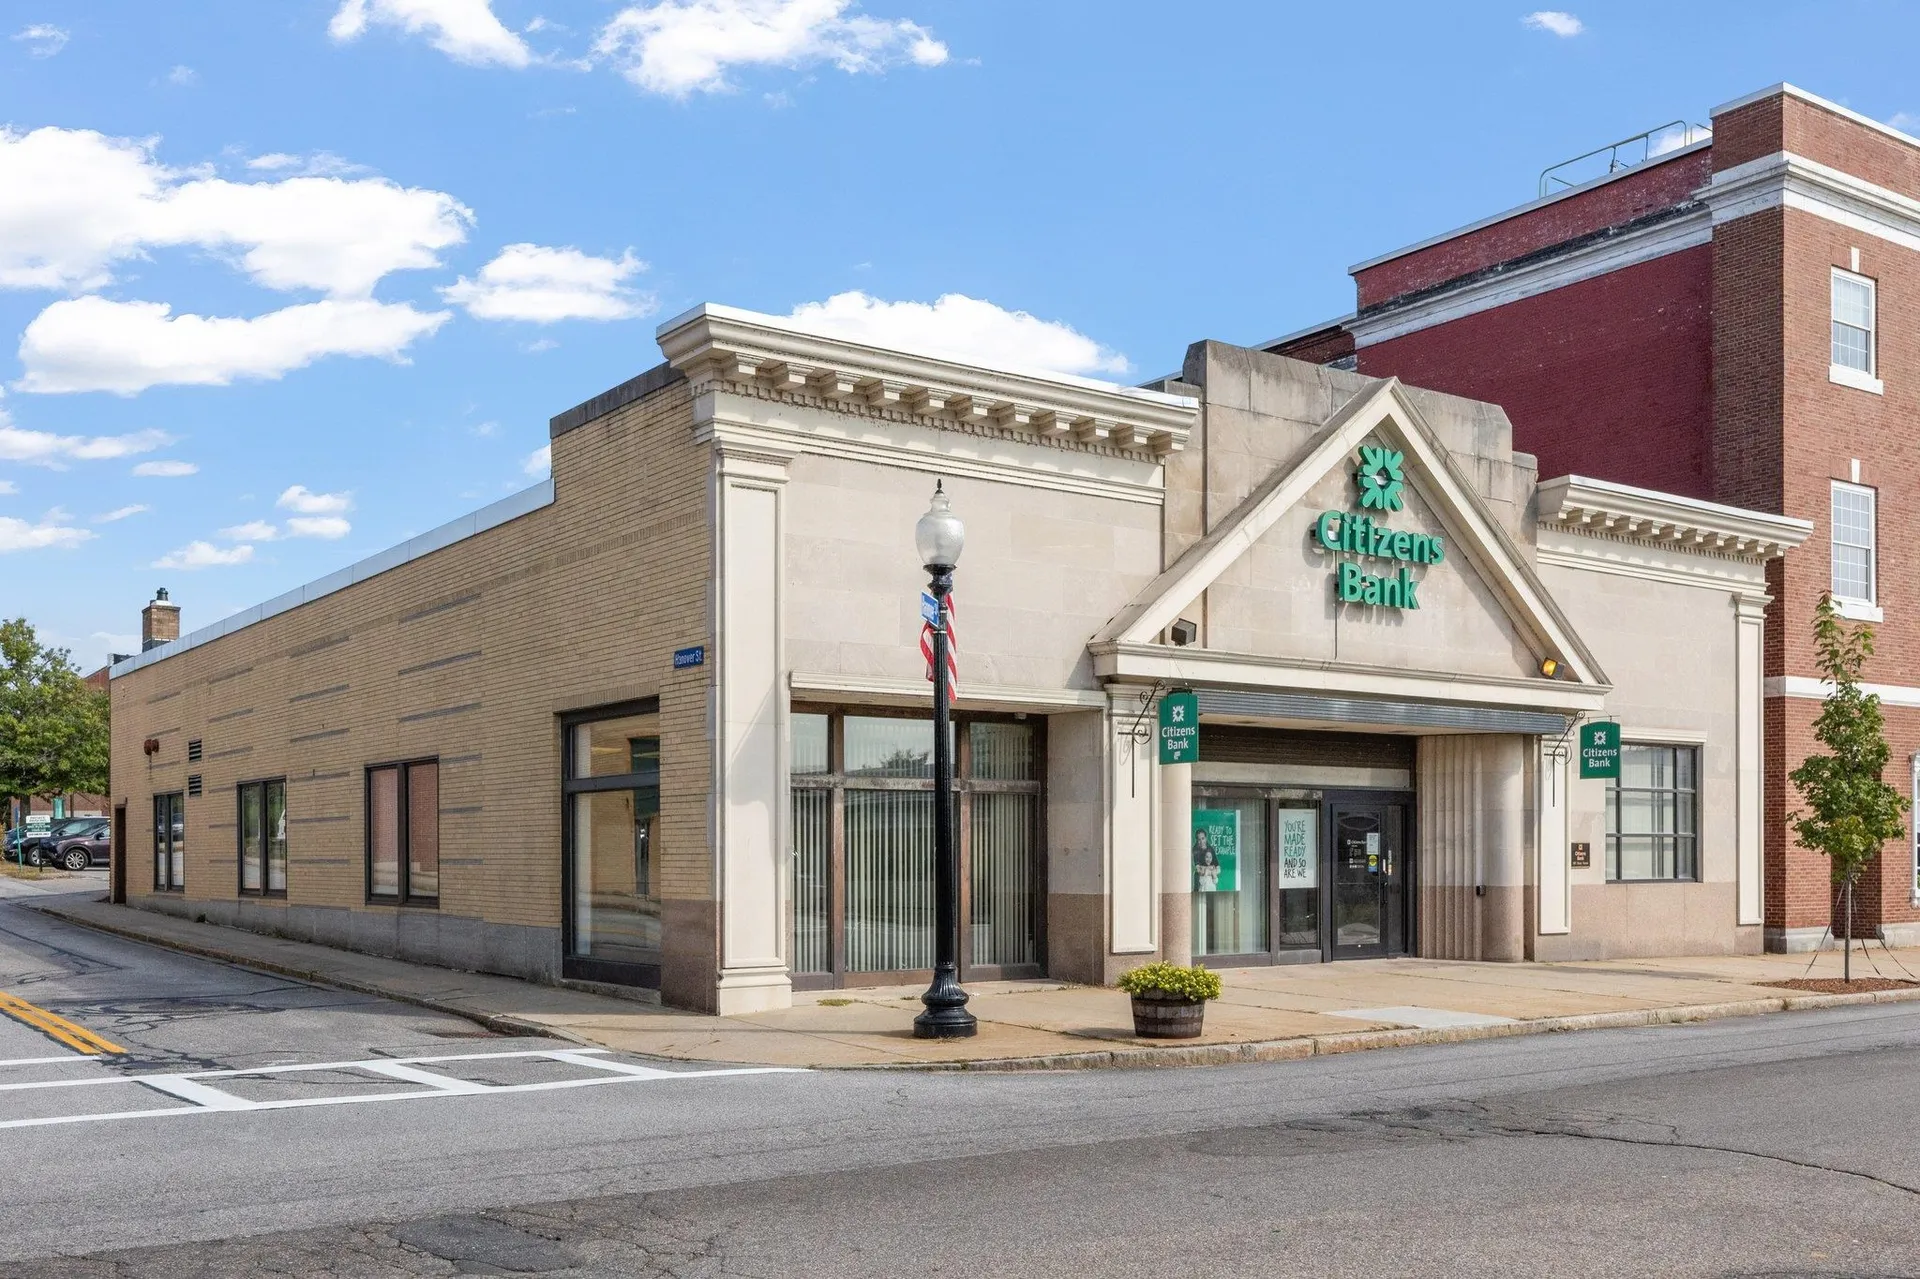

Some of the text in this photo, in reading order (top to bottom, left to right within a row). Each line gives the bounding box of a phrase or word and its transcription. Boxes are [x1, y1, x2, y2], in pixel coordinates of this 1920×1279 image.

[1315, 509, 1445, 565] Citizens
[1338, 561, 1420, 609] Bank
[675, 653, 695, 666] Hanover
[1161, 726, 1196, 738] Citizens
[1167, 737, 1189, 750] Bank
[1582, 748, 1618, 758] Citizens
[1588, 757, 1611, 768] Bank
[1284, 820, 1306, 833] YOU'RE
[1210, 835, 1234, 847] SET THE
[1284, 833, 1306, 845] MADE
[1284, 845, 1306, 858] READY
[1284, 858, 1307, 868] AND SO
[1284, 868, 1307, 879] ARE WE
